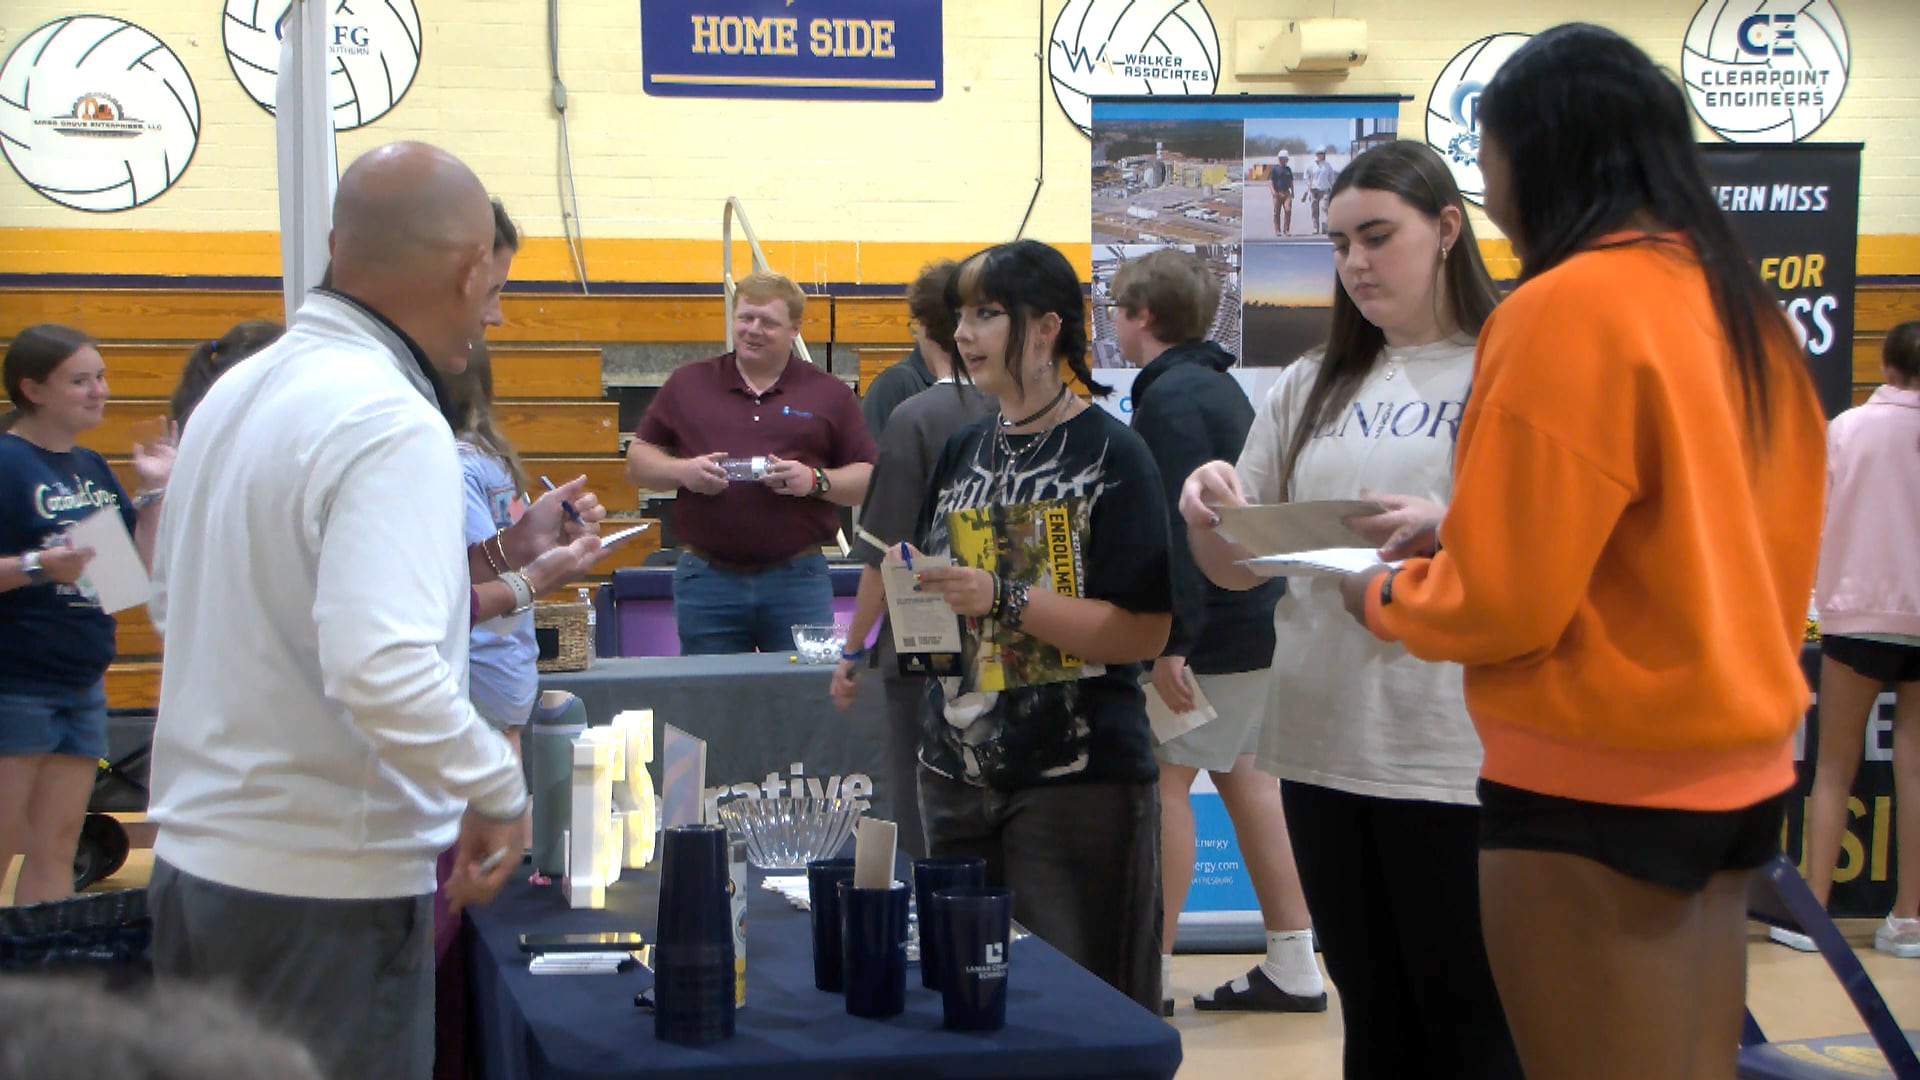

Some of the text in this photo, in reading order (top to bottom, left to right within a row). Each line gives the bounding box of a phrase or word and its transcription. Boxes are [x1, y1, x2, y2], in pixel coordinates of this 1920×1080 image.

[691, 15, 895, 58] HOME SIDE
[1125, 54, 1183, 67] WALKER
[1124, 66, 1209, 81] ASSOCIATES
[1701, 70, 1830, 86] CLEARPOINT
[1705, 92, 1825, 107] ENGINEERS
[1713, 185, 1767, 212] ERN
[1759, 254, 1827, 290] FOR
[1777, 296, 1839, 356] SS
[1049, 513, 1074, 598] ENROLLME
[1193, 861, 1239, 873] ergy.com
